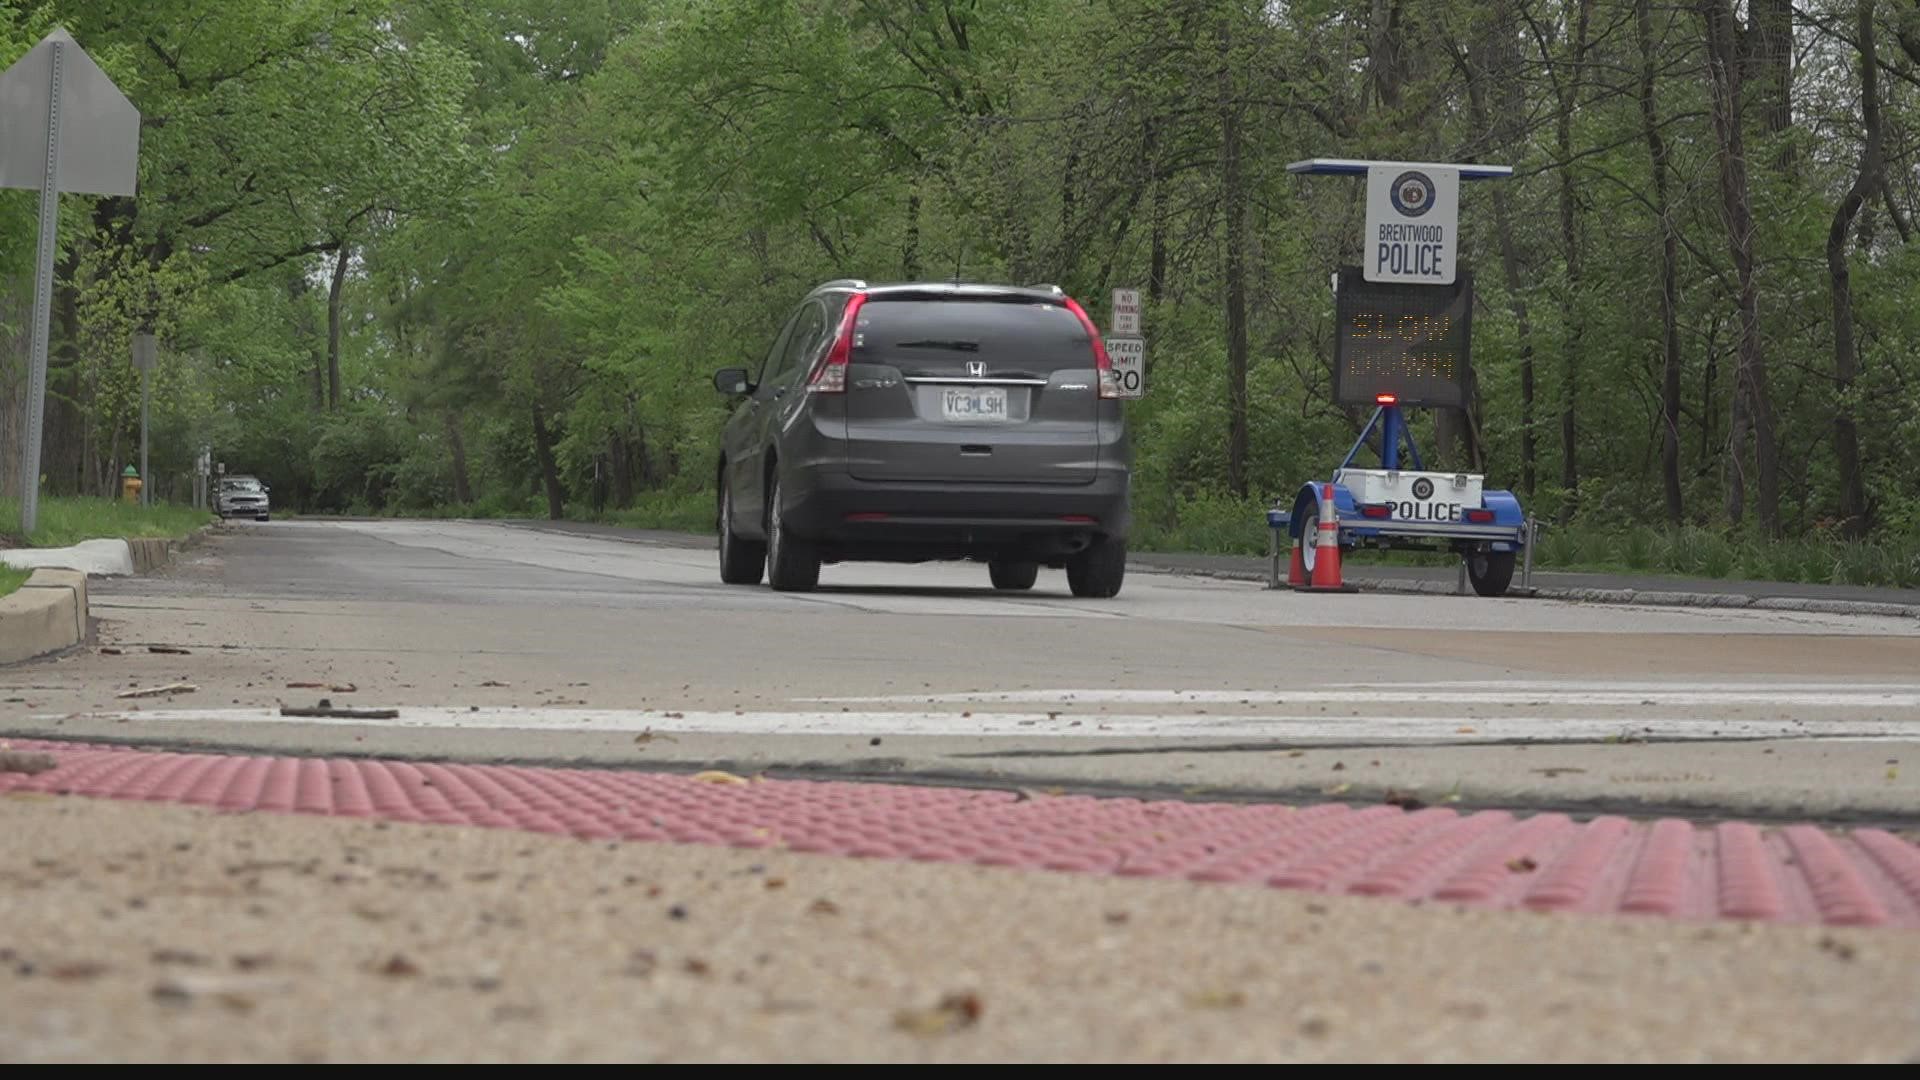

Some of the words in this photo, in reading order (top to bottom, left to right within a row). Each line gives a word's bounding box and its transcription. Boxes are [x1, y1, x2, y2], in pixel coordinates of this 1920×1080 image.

[1379, 224, 1442, 242] BRENTWOOD
[1378, 243, 1443, 275] POLICE
[1121, 295, 1132, 303] NO
[1352, 313, 1449, 341] SLOW
[1108, 343, 1141, 352] SPEED
[1351, 351, 1452, 380] DOWN
[1385, 500, 1461, 521] POLICE
